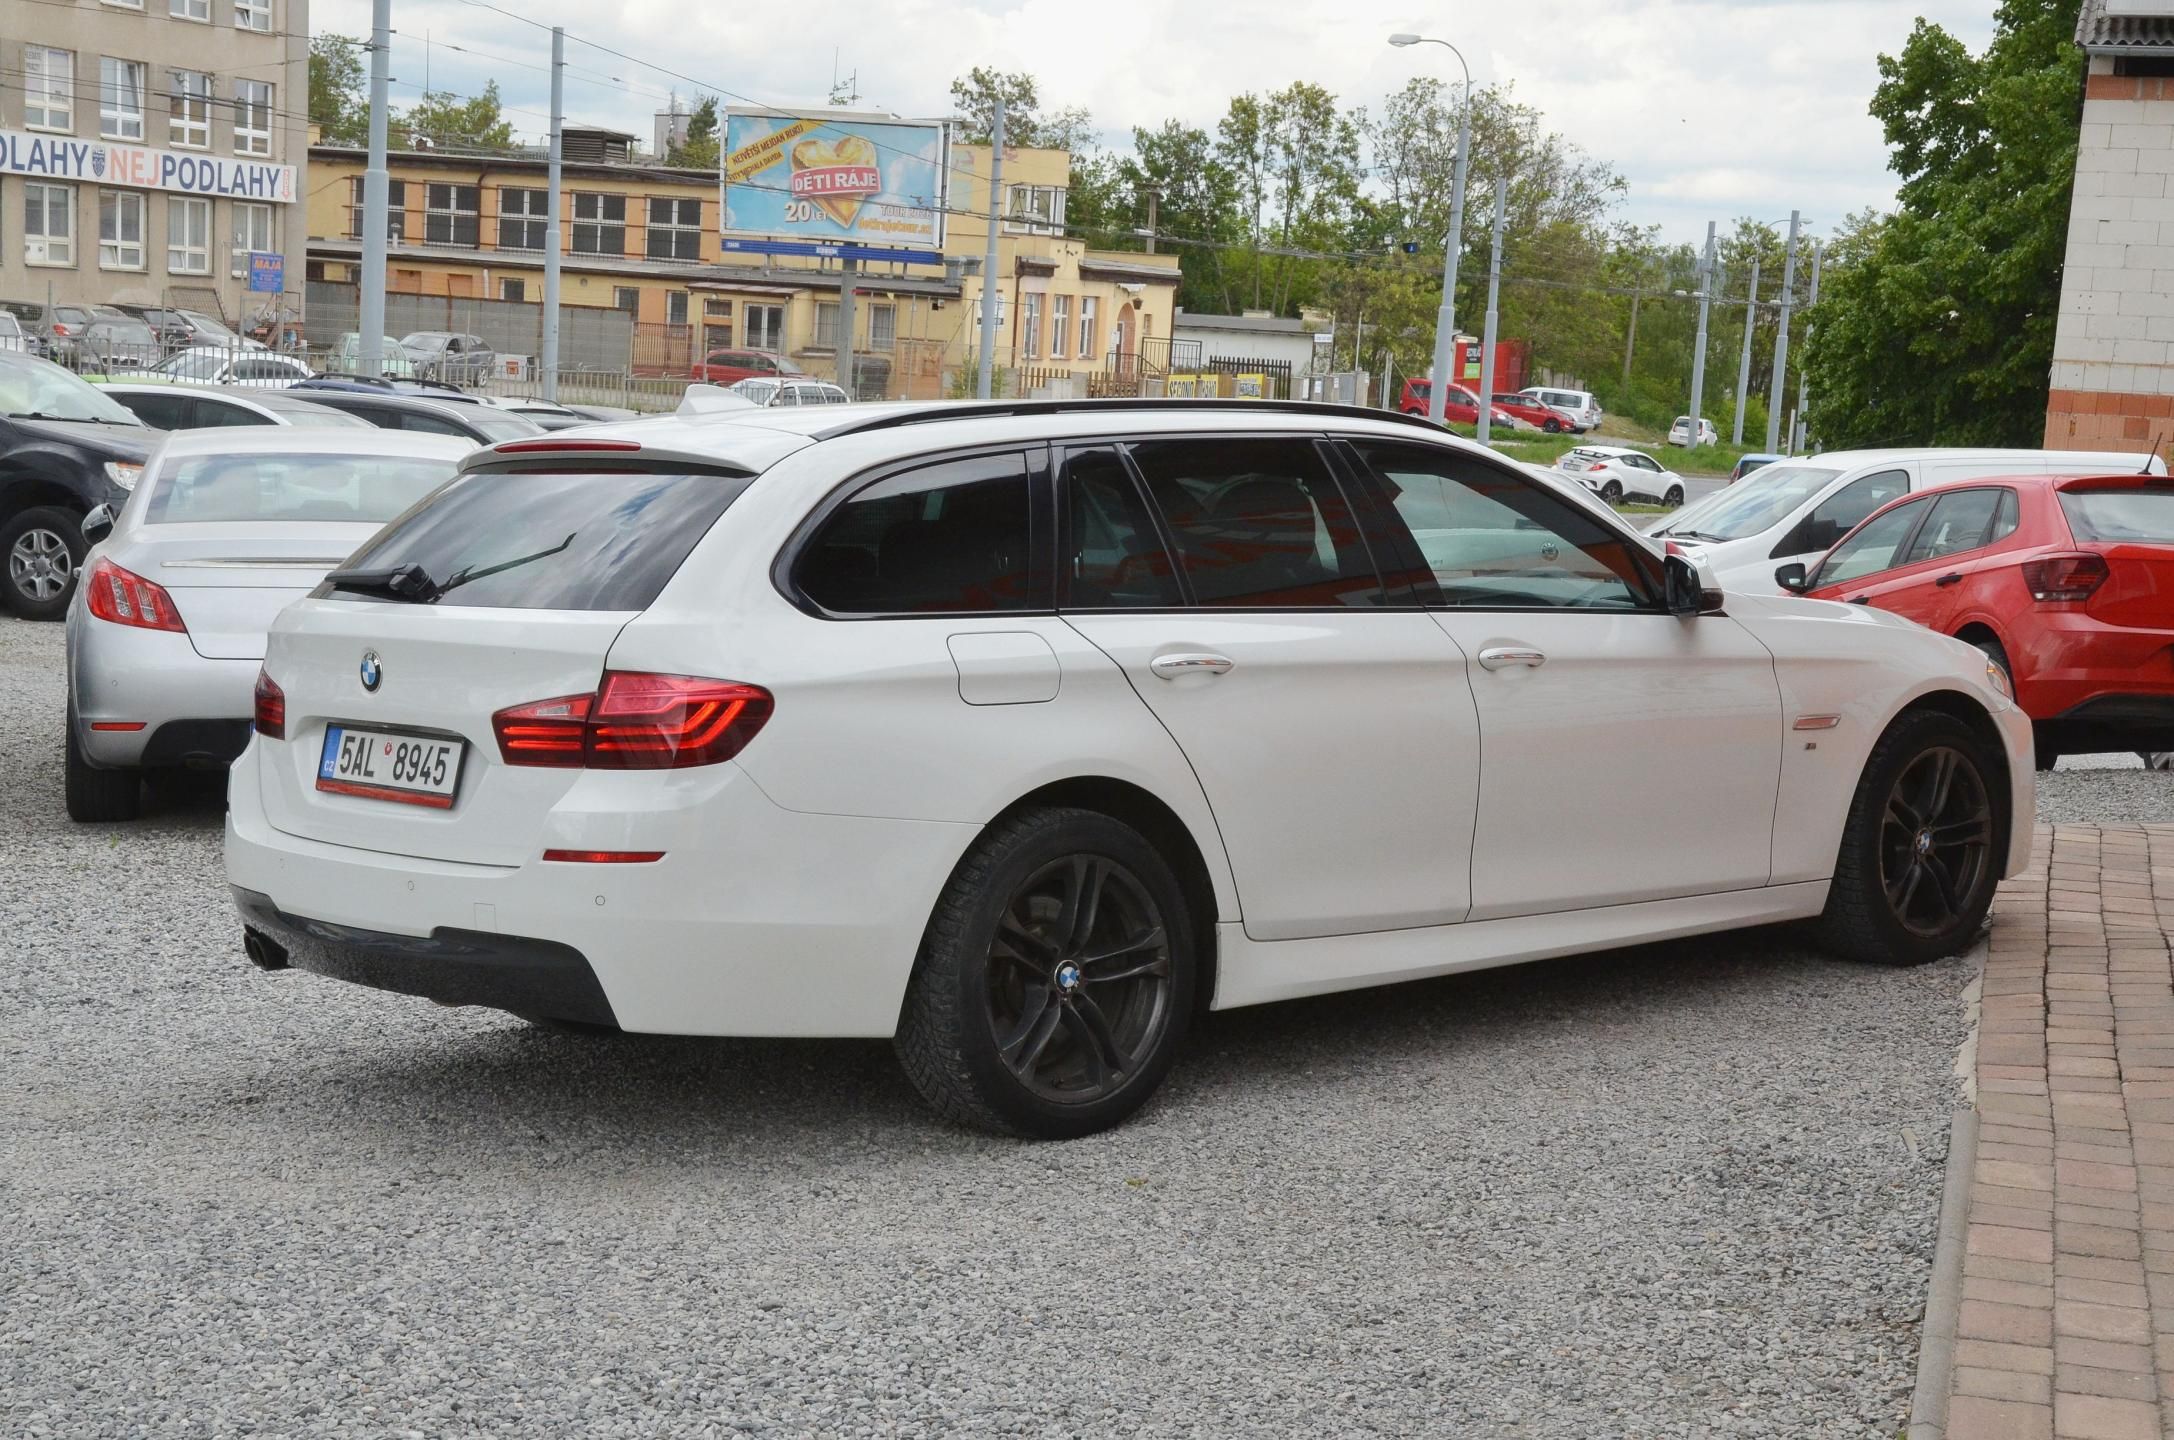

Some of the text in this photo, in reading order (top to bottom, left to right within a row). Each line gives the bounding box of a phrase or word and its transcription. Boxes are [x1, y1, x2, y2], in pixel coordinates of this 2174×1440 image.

[760, 133, 785, 152] MEJDAN
[785, 124, 804, 138] ROKU
[794, 168, 877, 192] DĚTI RÁJE
[784, 201, 811, 222] 20
[324, 760, 334, 771] CZ
[340, 735, 450, 786] 5AL 8945
